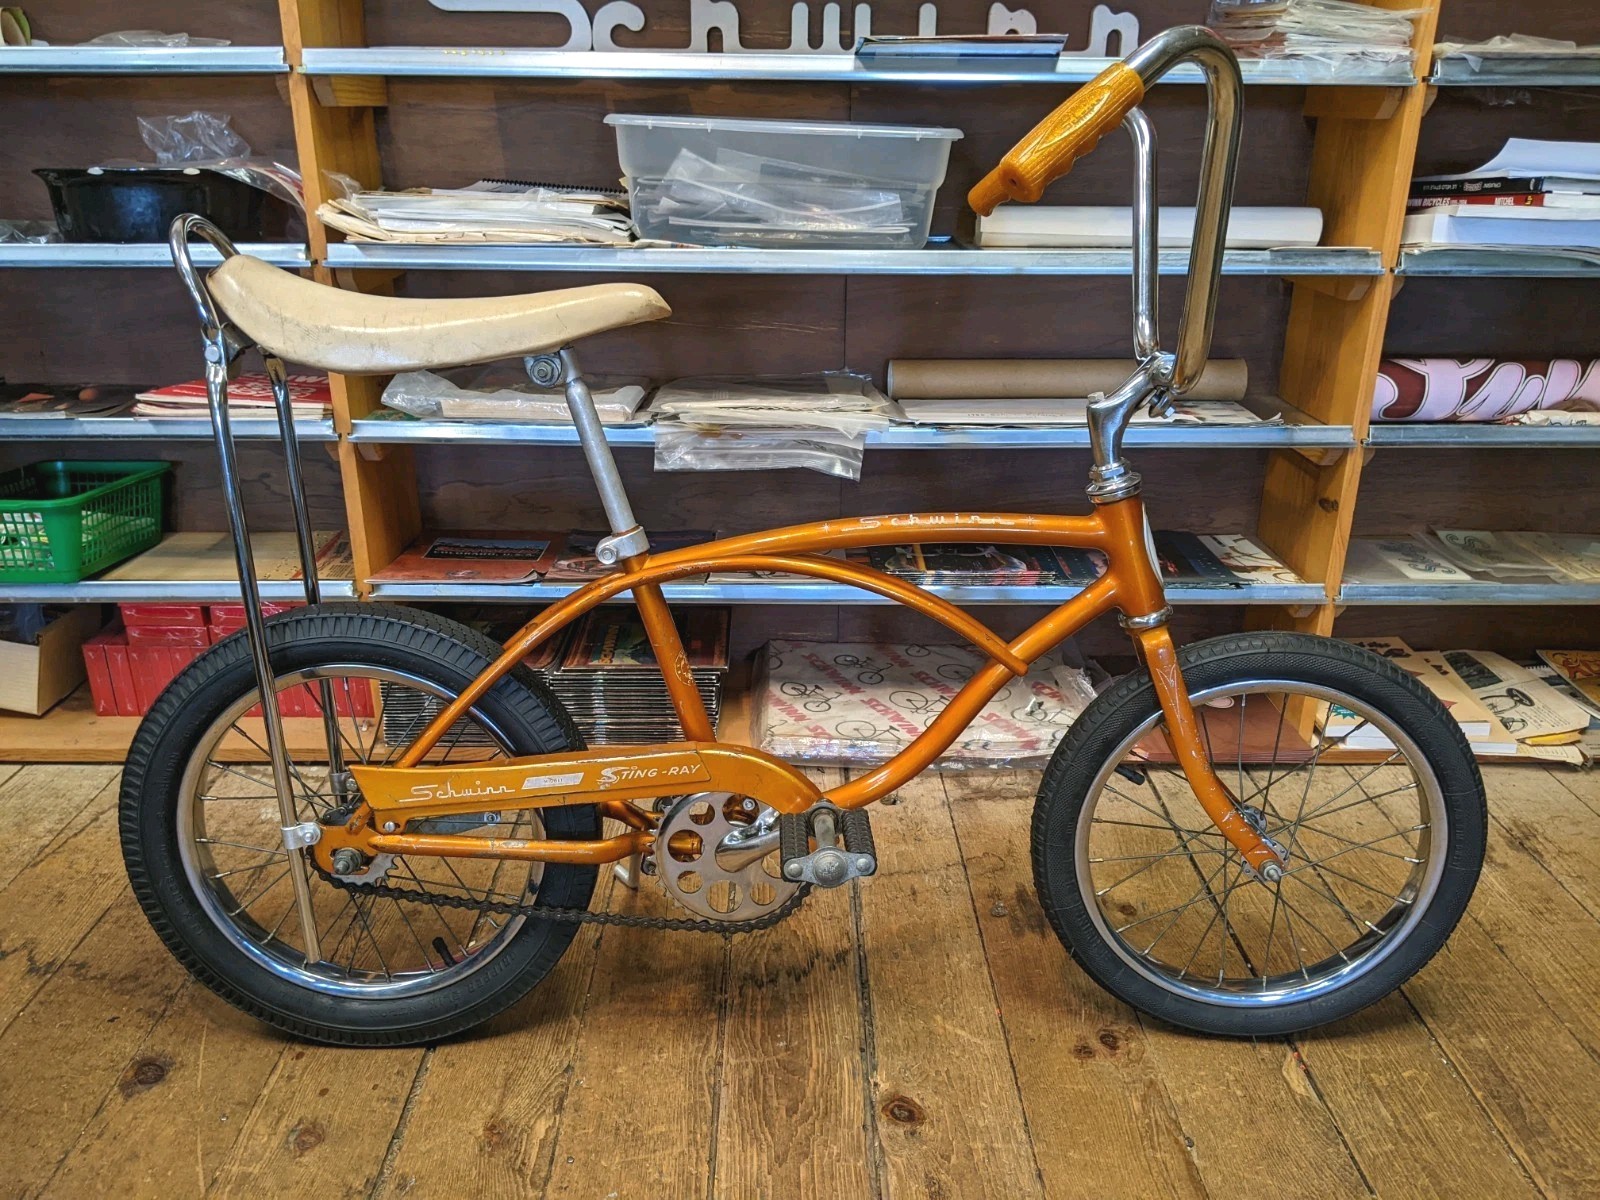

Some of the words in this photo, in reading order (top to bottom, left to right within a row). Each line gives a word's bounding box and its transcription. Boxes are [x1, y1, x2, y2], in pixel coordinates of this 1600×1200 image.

[841, 513, 1015, 532] Schwinn
[801, 653, 866, 695] SCHWINN
[859, 697, 924, 737] SCHWIN
[399, 780, 516, 802] Schwinn
